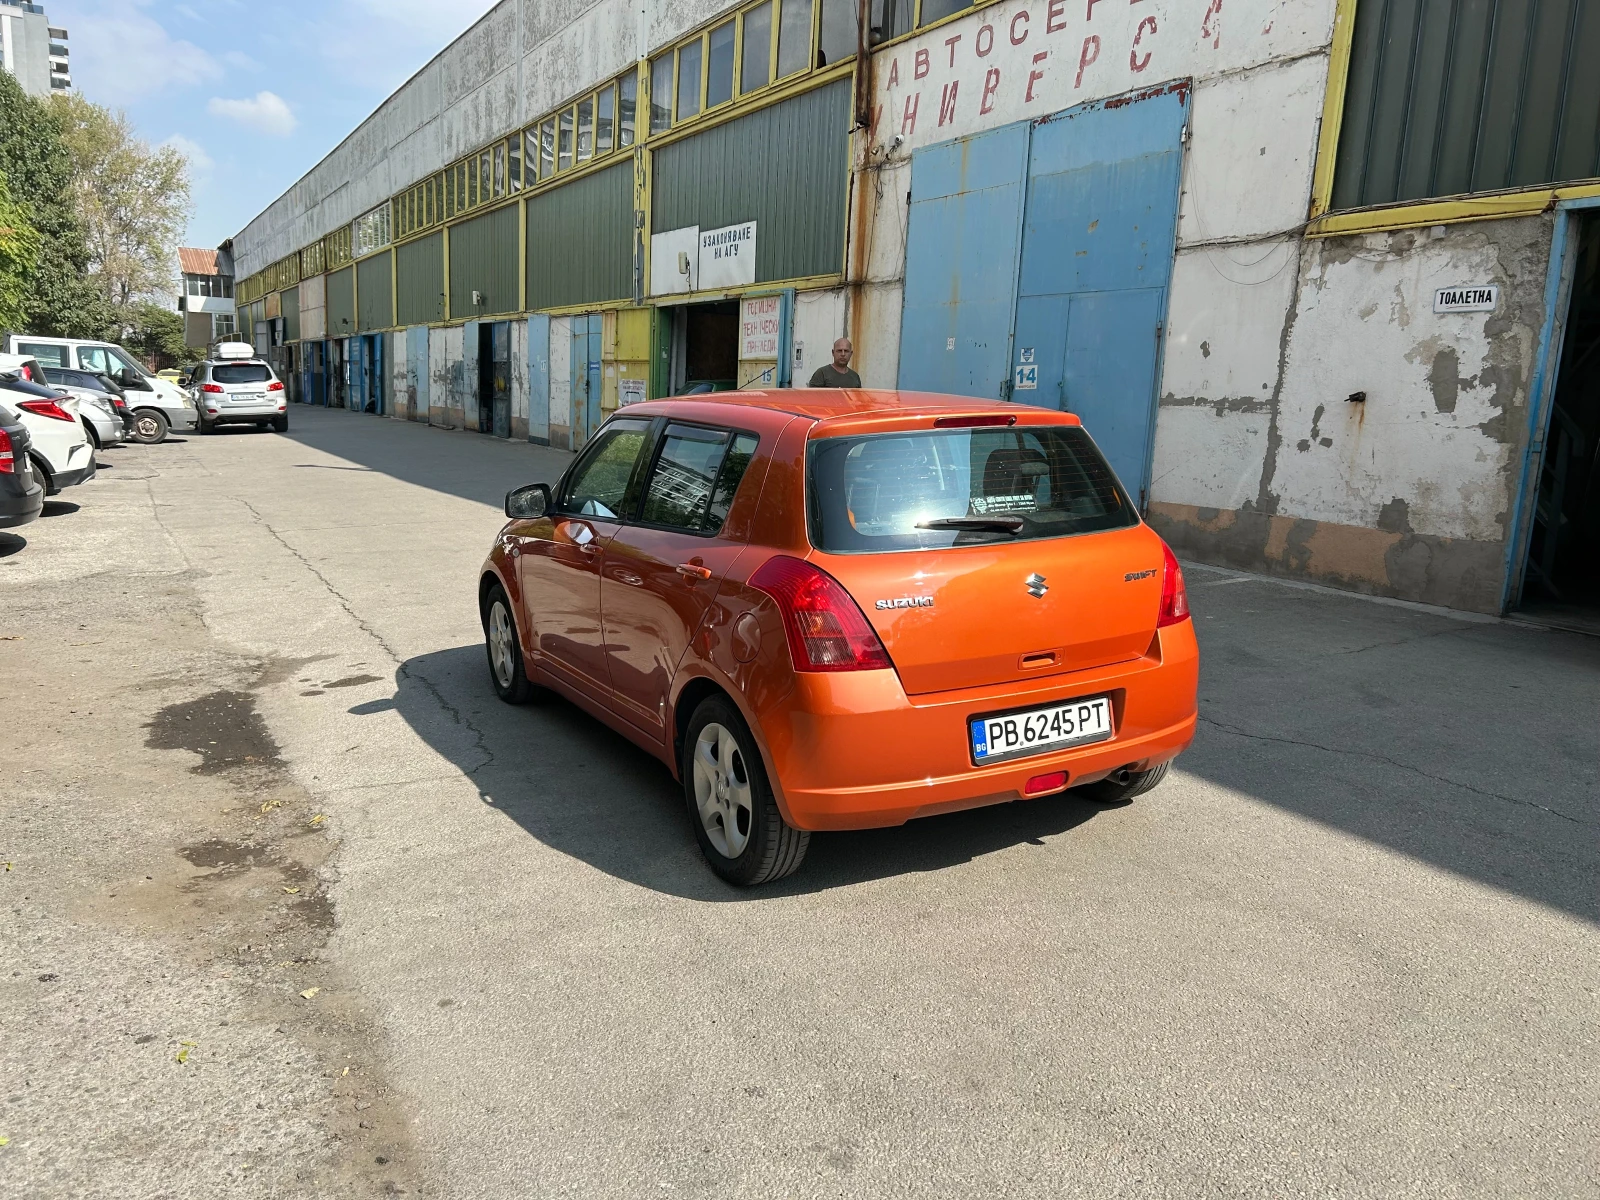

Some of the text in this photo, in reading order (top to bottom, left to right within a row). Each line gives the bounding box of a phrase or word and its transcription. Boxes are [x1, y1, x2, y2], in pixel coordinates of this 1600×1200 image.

[886, 0, 1139, 91] АВТОСЕ
[868, 0, 1274, 150] УНИВЕРСА
[703, 226, 751, 248] УЗАКОНЯВАНЕ
[714, 243, 739, 260] НА АГУ
[1439, 290, 1492, 305] ТОАЛЕТНА
[762, 369, 772, 382] 15
[1016, 367, 1037, 384] 14
[1124, 569, 1157, 582] SWIFT
[875, 596, 934, 610] SUZUKI
[976, 743, 987, 752] BG
